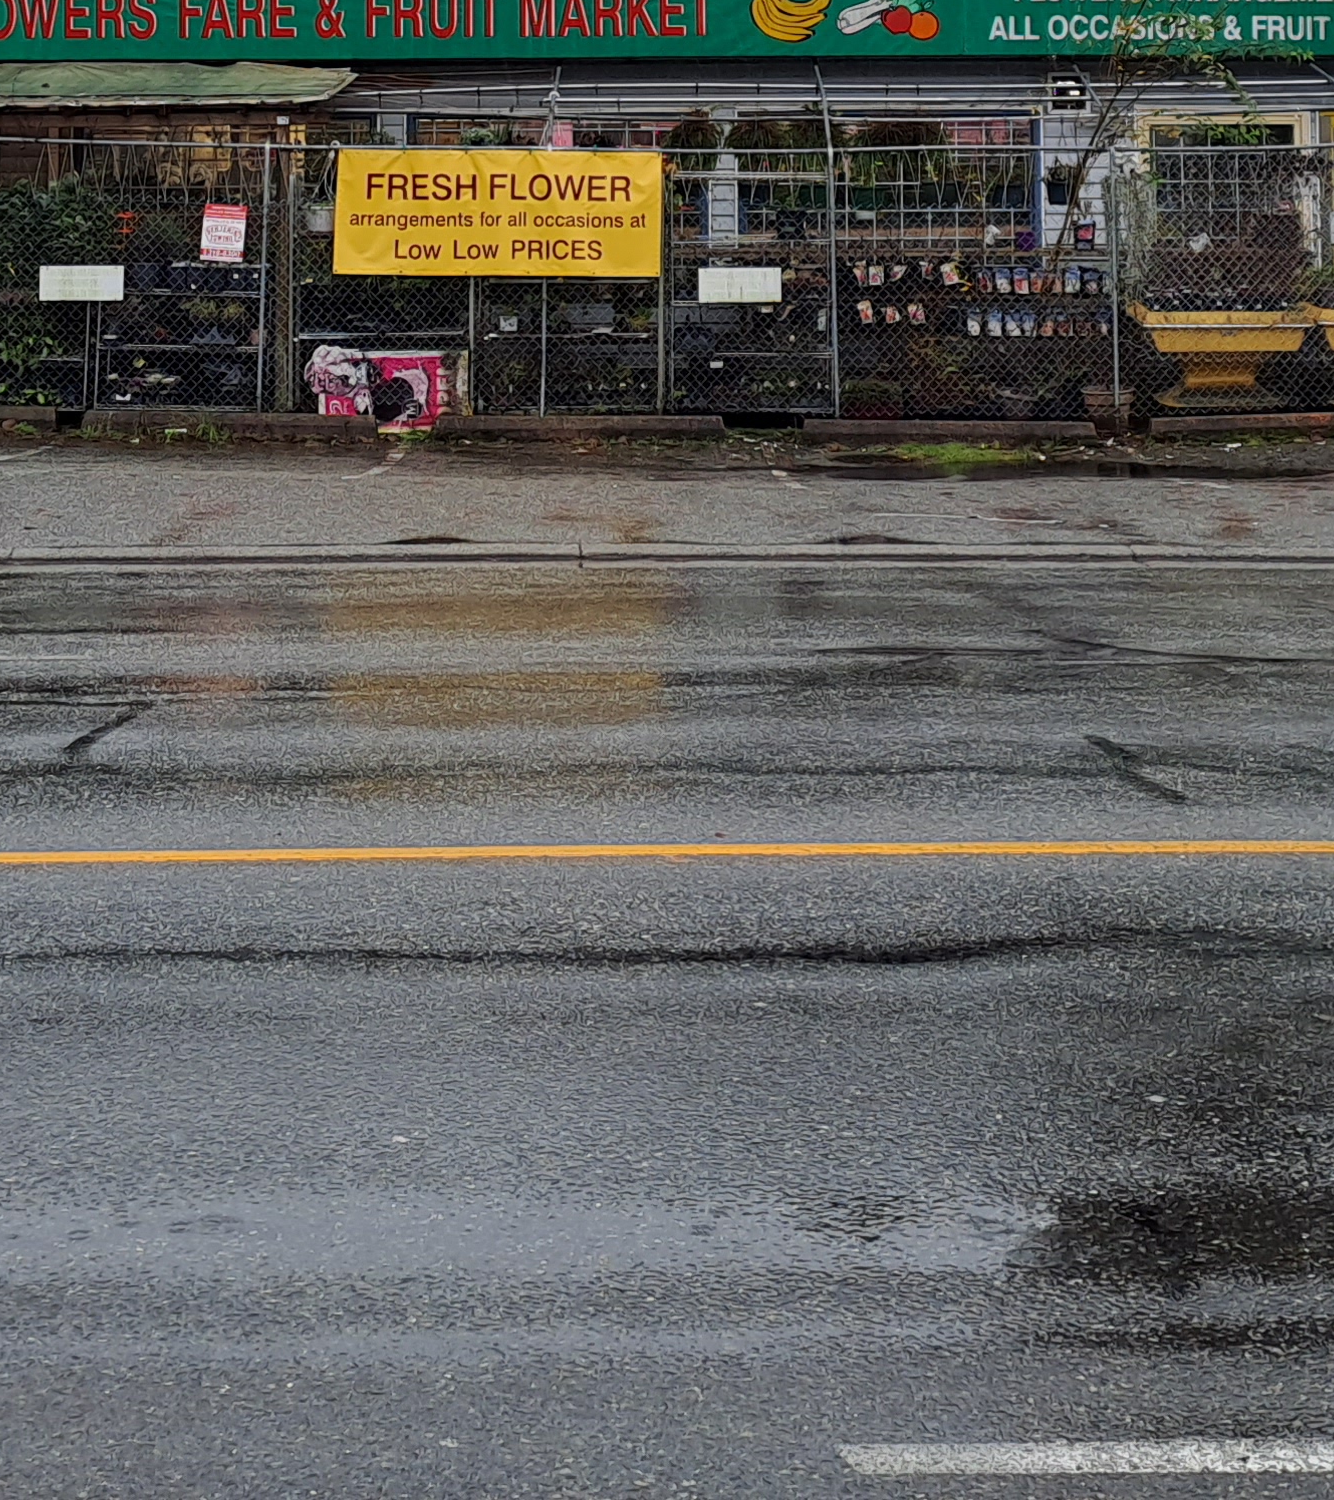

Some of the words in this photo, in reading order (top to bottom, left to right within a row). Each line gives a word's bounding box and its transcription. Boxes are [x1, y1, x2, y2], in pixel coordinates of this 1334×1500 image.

[989, 15, 1041, 41] ALL
[1223, 15, 1243, 41] &
[1251, 15, 1330, 41] FRUIT
[365, 172, 478, 202] FRESH
[488, 172, 632, 203] FLOWER
[348, 211, 475, 231] arrangements
[479, 210, 503, 228] for
[506, 210, 528, 228] all
[532, 211, 625, 230] occasions
[629, 212, 647, 229] at
[393, 238, 443, 261] Low
[452, 238, 500, 261] Low
[510, 238, 604, 262] PRICES
